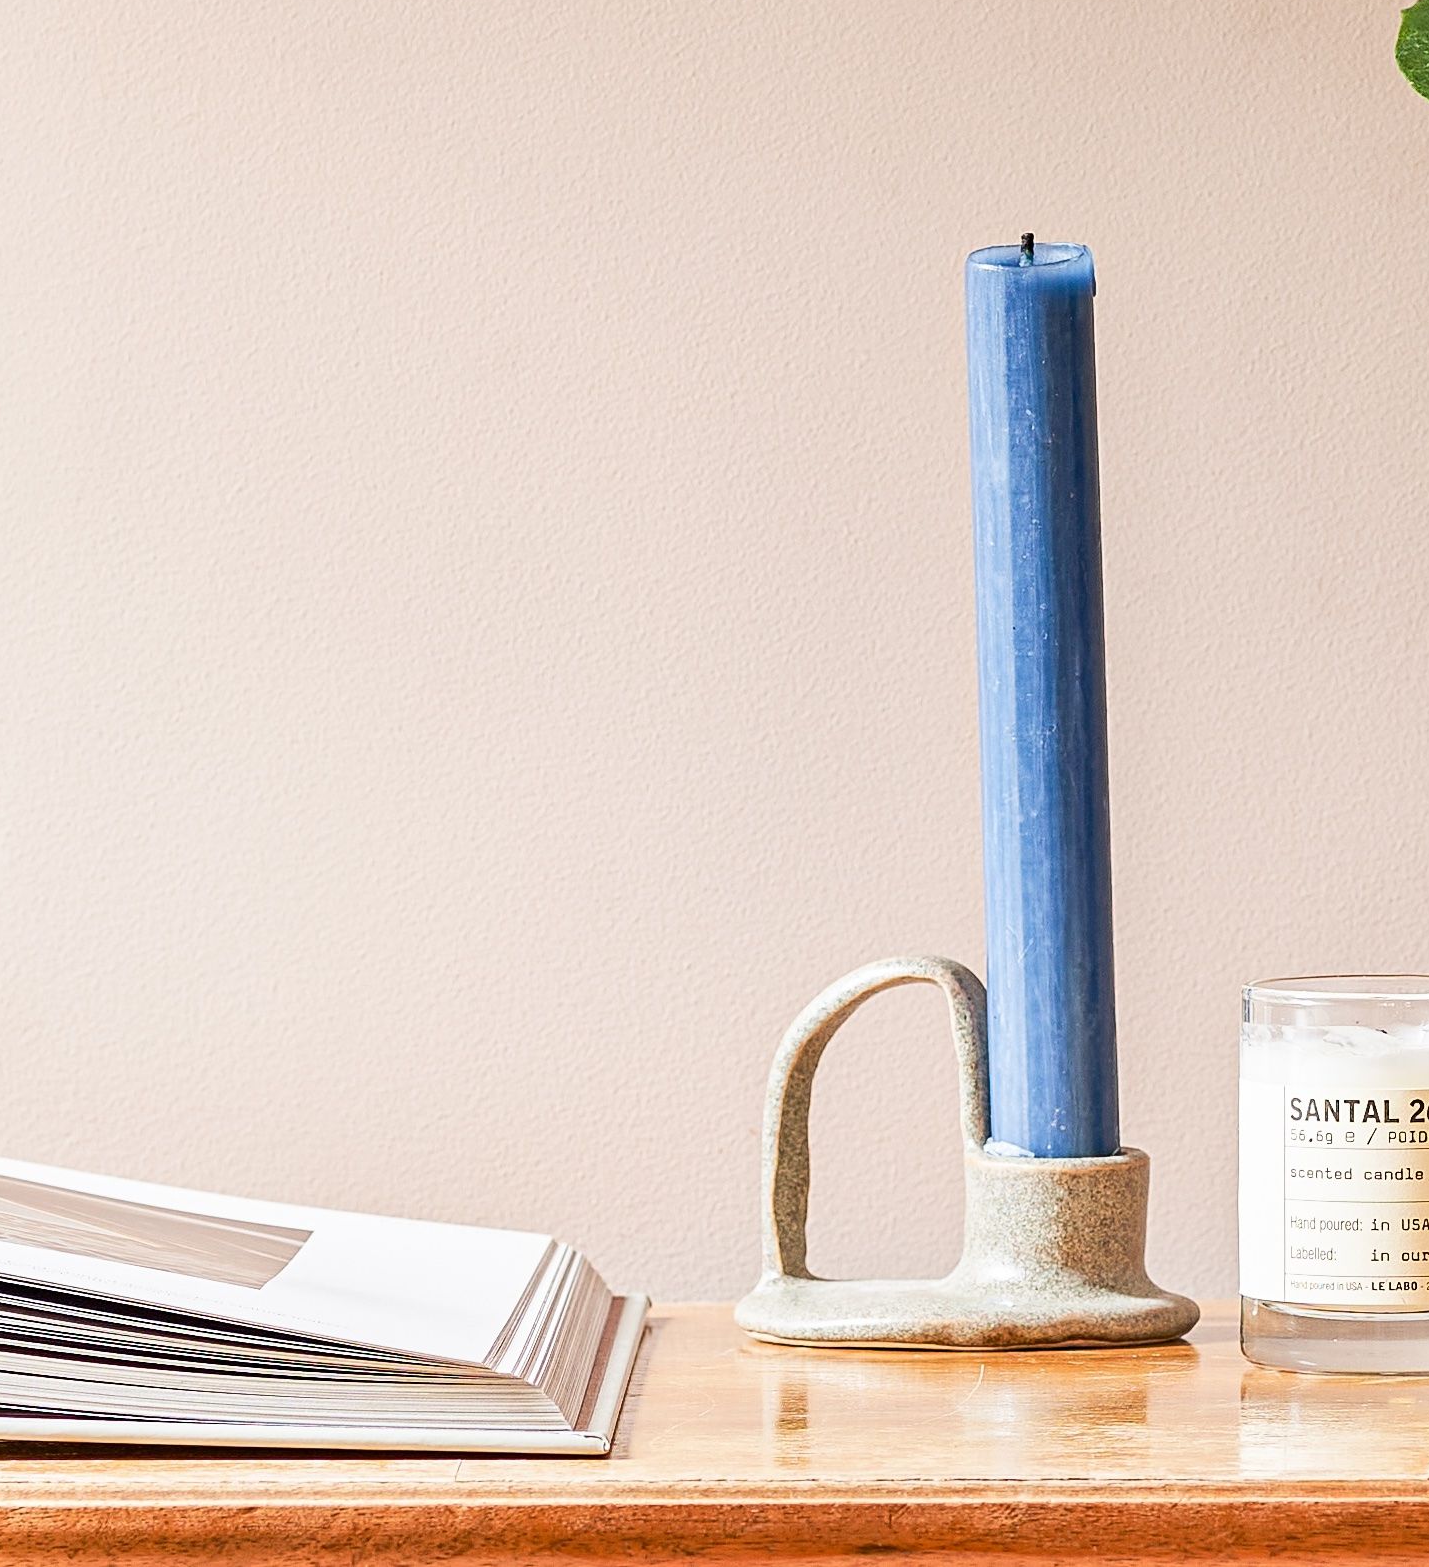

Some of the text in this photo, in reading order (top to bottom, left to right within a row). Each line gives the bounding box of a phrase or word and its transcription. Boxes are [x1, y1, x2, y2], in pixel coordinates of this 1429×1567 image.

[1290, 1098, 1399, 1123] SANTAL
[1290, 1128, 1333, 1144] 56.6g
[1290, 1167, 1352, 1180] scented
[1364, 1167, 1424, 1181] candle
[1290, 1216, 1316, 1231] Hand
[1320, 1218, 1363, 1234] poured:
[1371, 1218, 1390, 1231] in
[1290, 1246, 1337, 1261] Labelled:
[1371, 1249, 1390, 1262] in
[1290, 1280, 1308, 1289] Hand
[1309, 1280, 1335, 1291] poured
[1337, 1281, 1344, 1290] in
[1346, 1281, 1363, 1291] USA
[1371, 1281, 1385, 1291] LE
[1388, 1281, 1418, 1291] LABO
